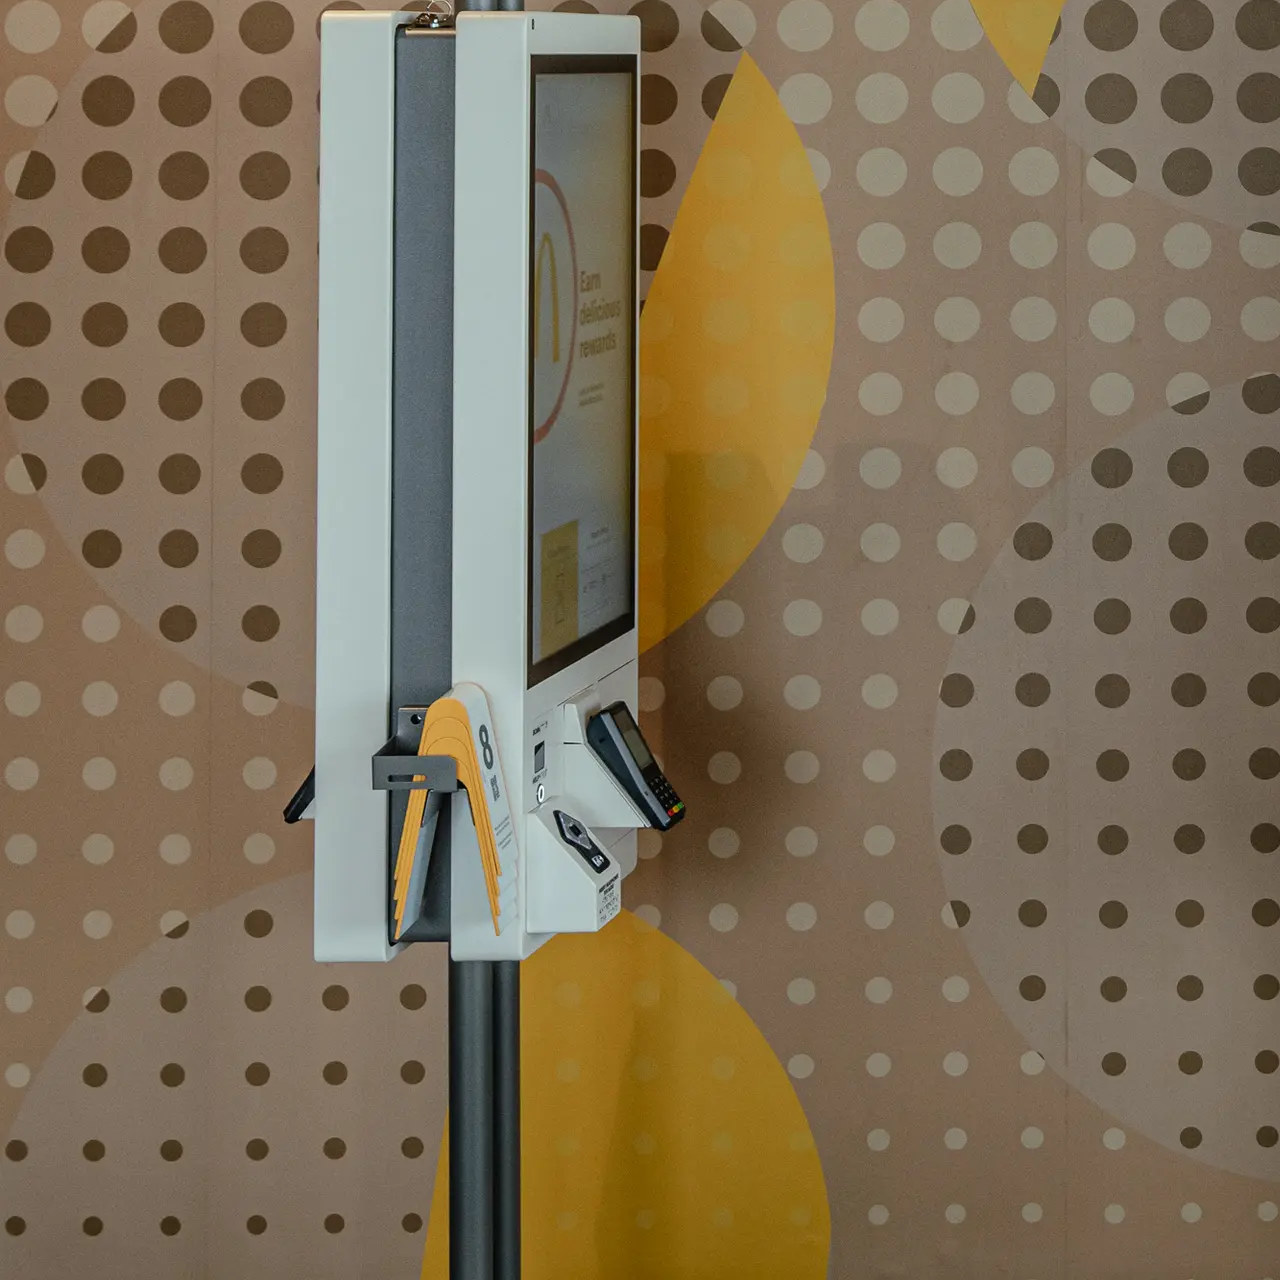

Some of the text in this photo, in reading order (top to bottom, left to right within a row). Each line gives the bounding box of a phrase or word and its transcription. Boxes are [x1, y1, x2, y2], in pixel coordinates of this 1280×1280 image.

[580, 271, 601, 293] Earn
[579, 298, 620, 326] delicious
[580, 332, 616, 358] rewards
[479, 724, 493, 769] 8
